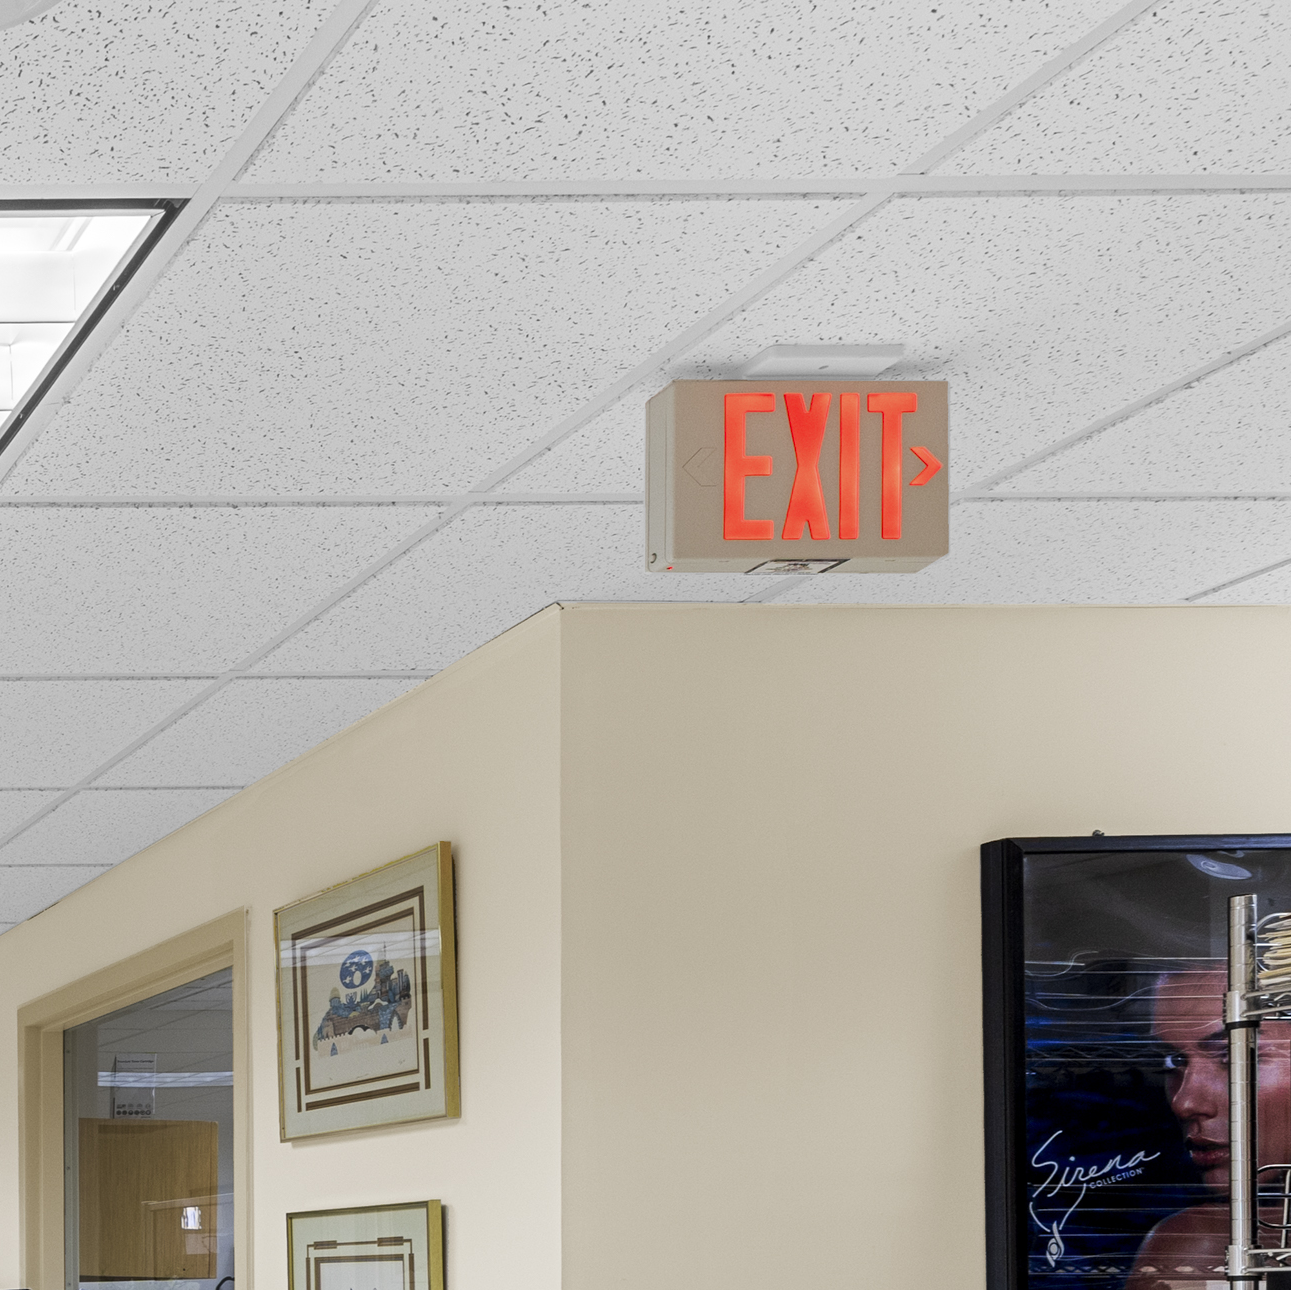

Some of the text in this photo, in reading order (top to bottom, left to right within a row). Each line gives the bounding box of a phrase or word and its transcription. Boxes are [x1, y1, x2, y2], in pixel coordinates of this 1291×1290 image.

[723, 392, 918, 541] EXIT
[1031, 1129, 1161, 1198] Sirena
[1089, 1168, 1143, 1190] COLLECTION
